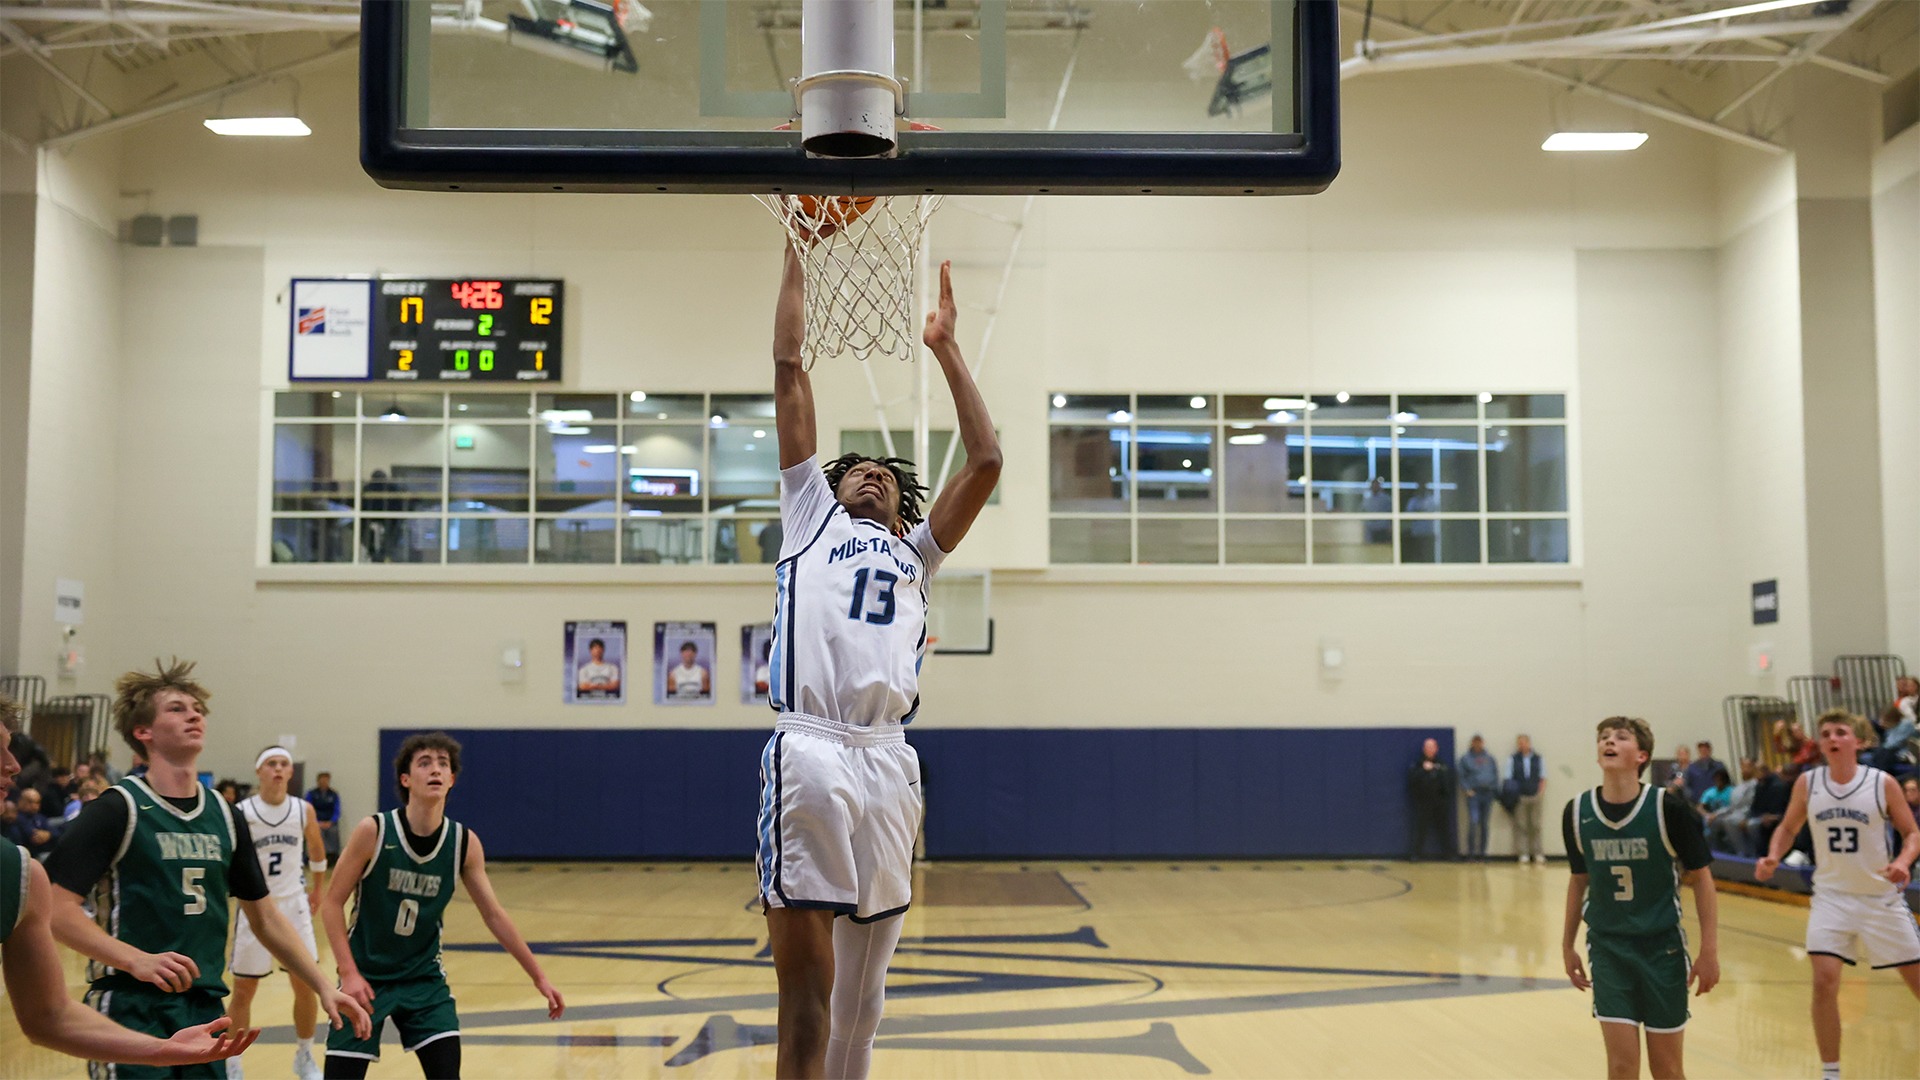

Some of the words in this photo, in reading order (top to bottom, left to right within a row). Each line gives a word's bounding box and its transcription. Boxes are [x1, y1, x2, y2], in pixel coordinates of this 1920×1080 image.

[401, 297, 424, 324] 17
[530, 297, 553, 325] 12
[478, 314, 493, 336] 2
[398, 350, 413, 371] 2
[455, 350, 469, 371] 0
[479, 350, 494, 371] 0
[535, 350, 543, 371] 1
[848, 567, 898, 625] 13
[155, 832, 222, 861] WOLVES
[1591, 837, 1649, 861] WOLVES
[1828, 827, 1859, 853] 23
[268, 852, 283, 876] 2
[182, 867, 207, 915] 5
[388, 867, 441, 897] WOLVES
[1610, 865, 1634, 901] 3
[394, 899, 419, 936] 0
